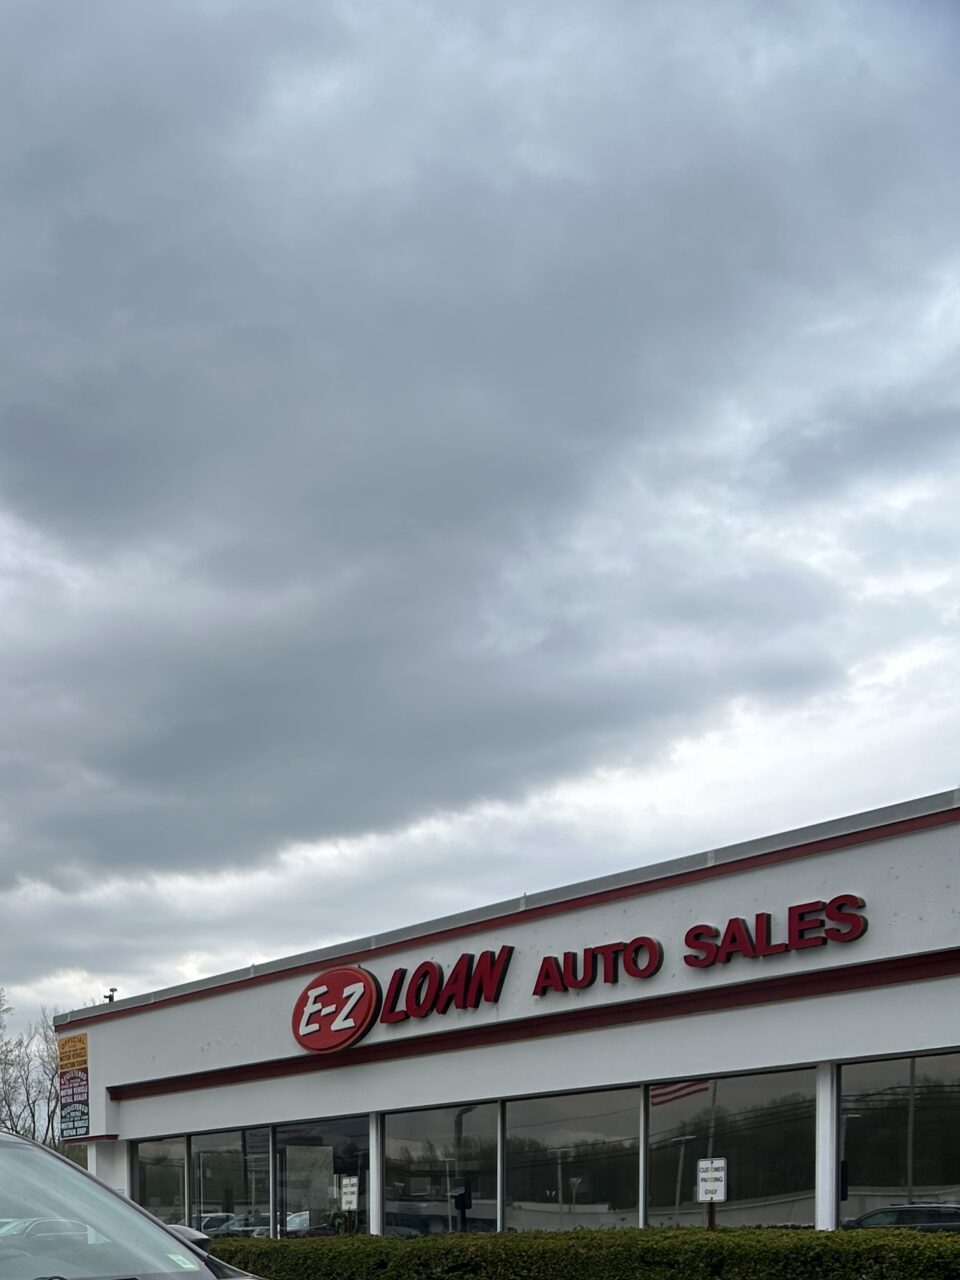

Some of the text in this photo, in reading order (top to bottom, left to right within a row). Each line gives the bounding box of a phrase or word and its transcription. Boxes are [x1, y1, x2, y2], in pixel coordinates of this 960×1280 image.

[299, 894, 868, 1036] E-Z LOAN AUTO SALES
